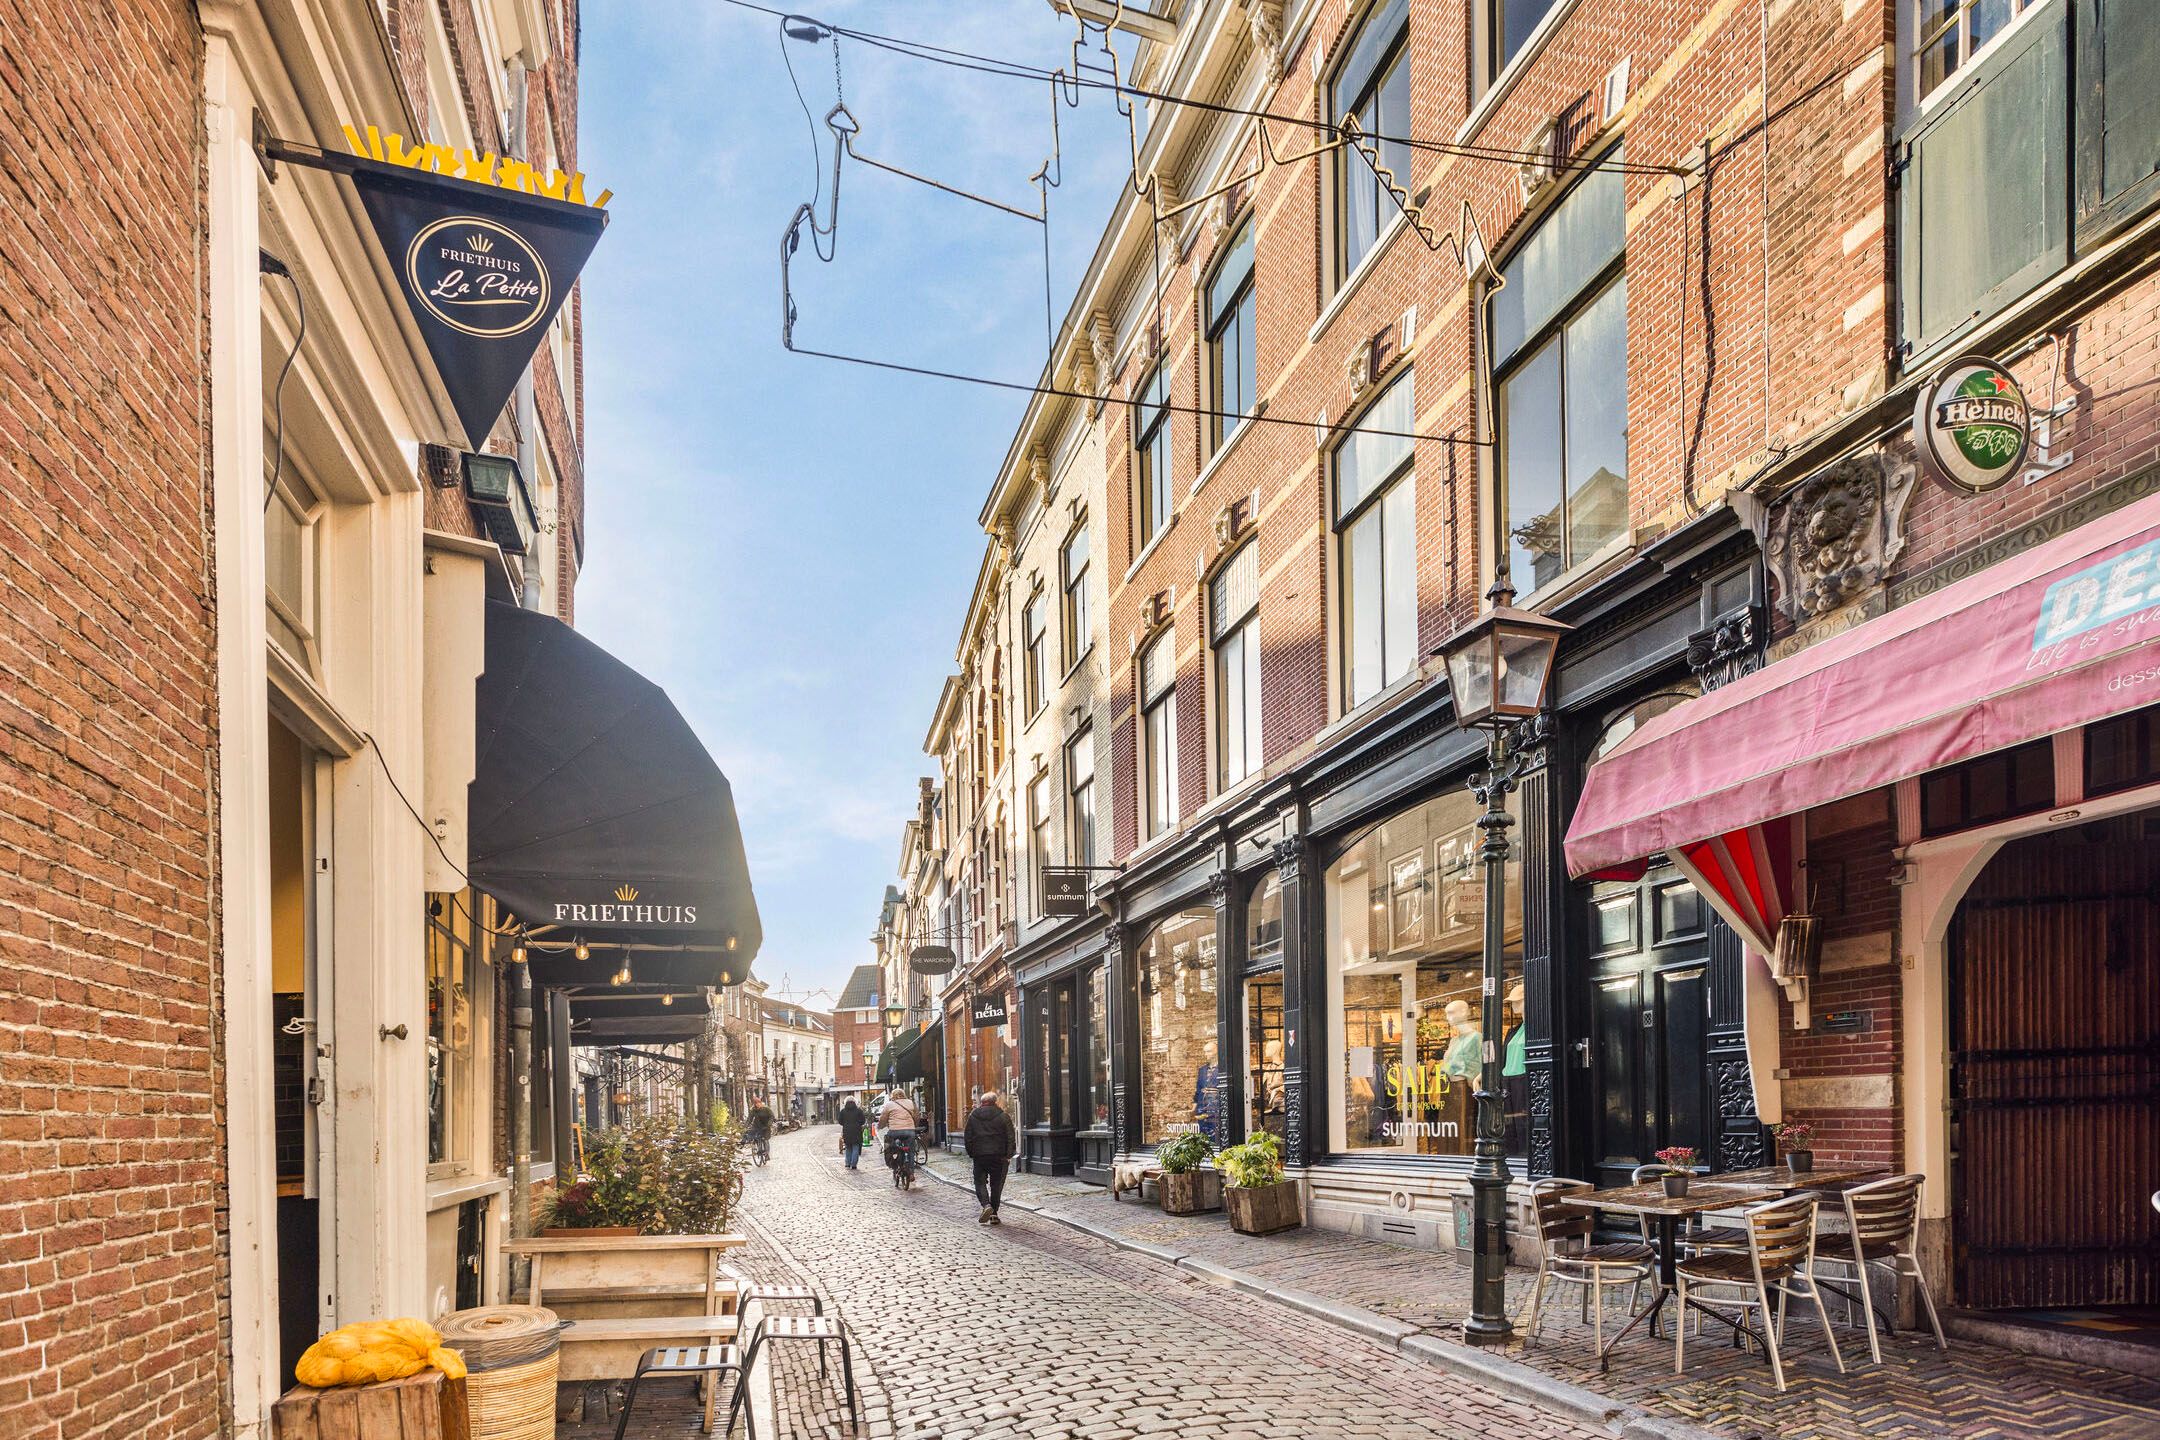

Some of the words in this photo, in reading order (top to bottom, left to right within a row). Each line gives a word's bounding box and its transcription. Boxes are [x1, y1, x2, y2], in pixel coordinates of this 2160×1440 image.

[441, 248, 521, 273] FRIETHUIS
[430, 269, 470, 298] La
[475, 272, 540, 298] Petite
[2080, 630, 2104, 650] is
[554, 903, 697, 924] FRIETHUIS
[1387, 1065, 1450, 1096] SALE
[1382, 1121, 1458, 1138] summum
